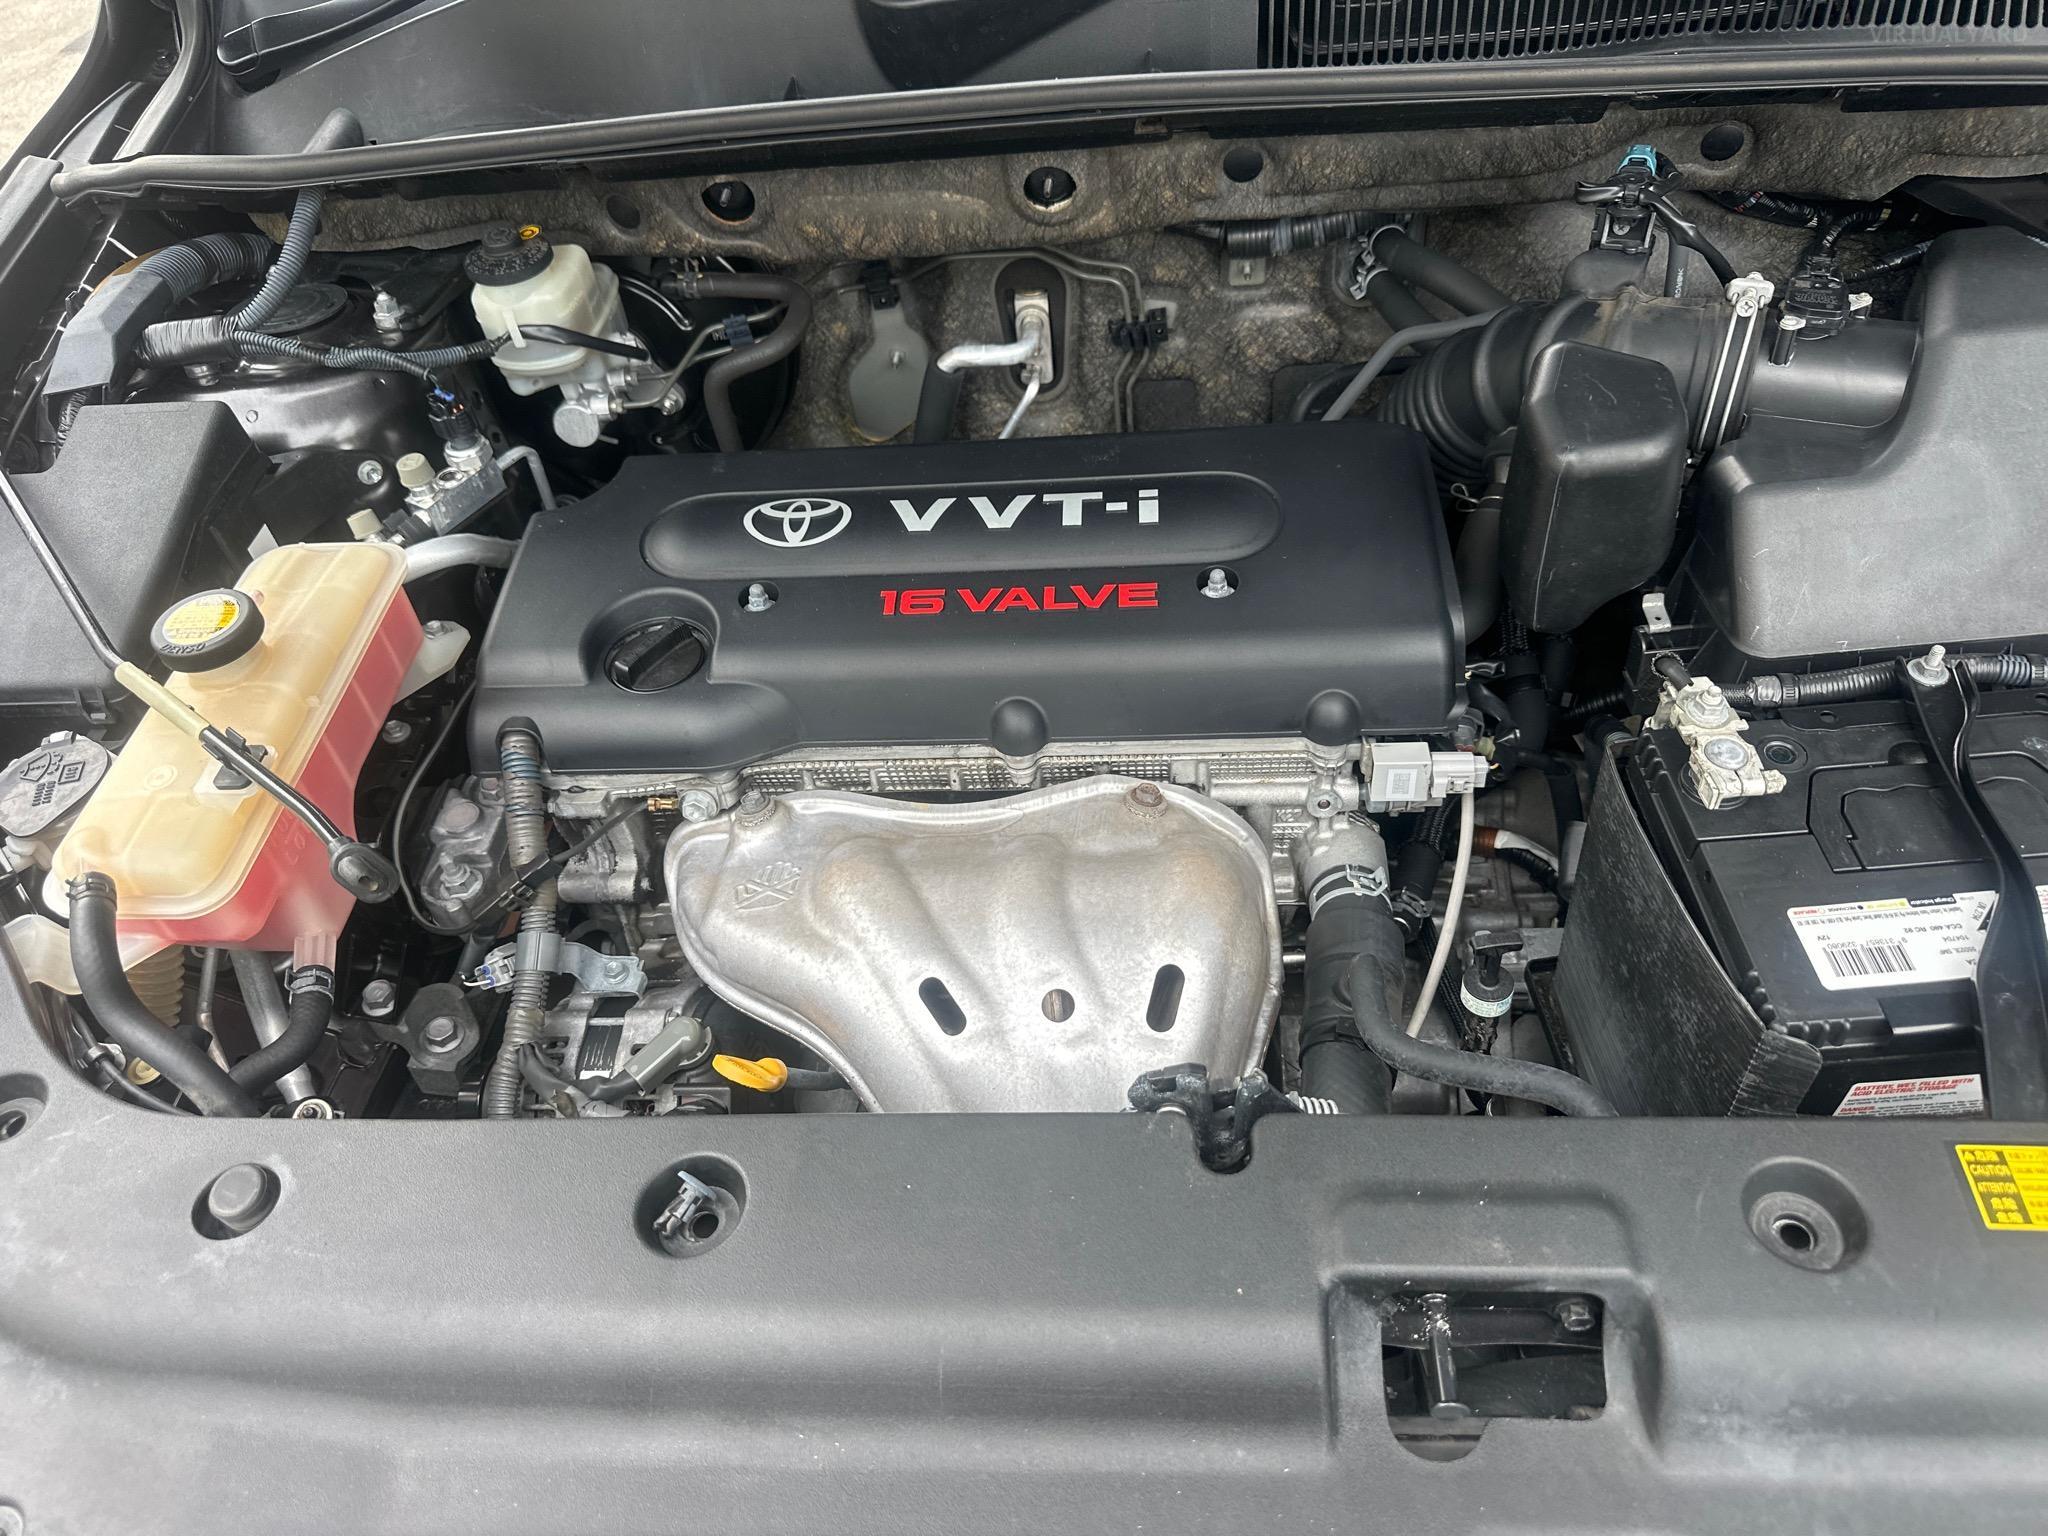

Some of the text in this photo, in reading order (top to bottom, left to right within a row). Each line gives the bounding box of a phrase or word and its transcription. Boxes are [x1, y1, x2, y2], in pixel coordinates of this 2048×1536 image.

[889, 488, 1160, 532] VVT-i
[880, 582, 1159, 616] 16 VALVE
[160, 642, 207, 654] DENSO
[1826, 941, 1857, 950] 329080
[1918, 1079, 1950, 1087] FILLED
[1873, 1087, 1915, 1095] ELECTRIC
[1916, 1084, 1958, 1092] STORAGE
[1969, 1164, 2011, 1177] CAUTION
[1976, 1182, 2019, 1194] ATTENTION
